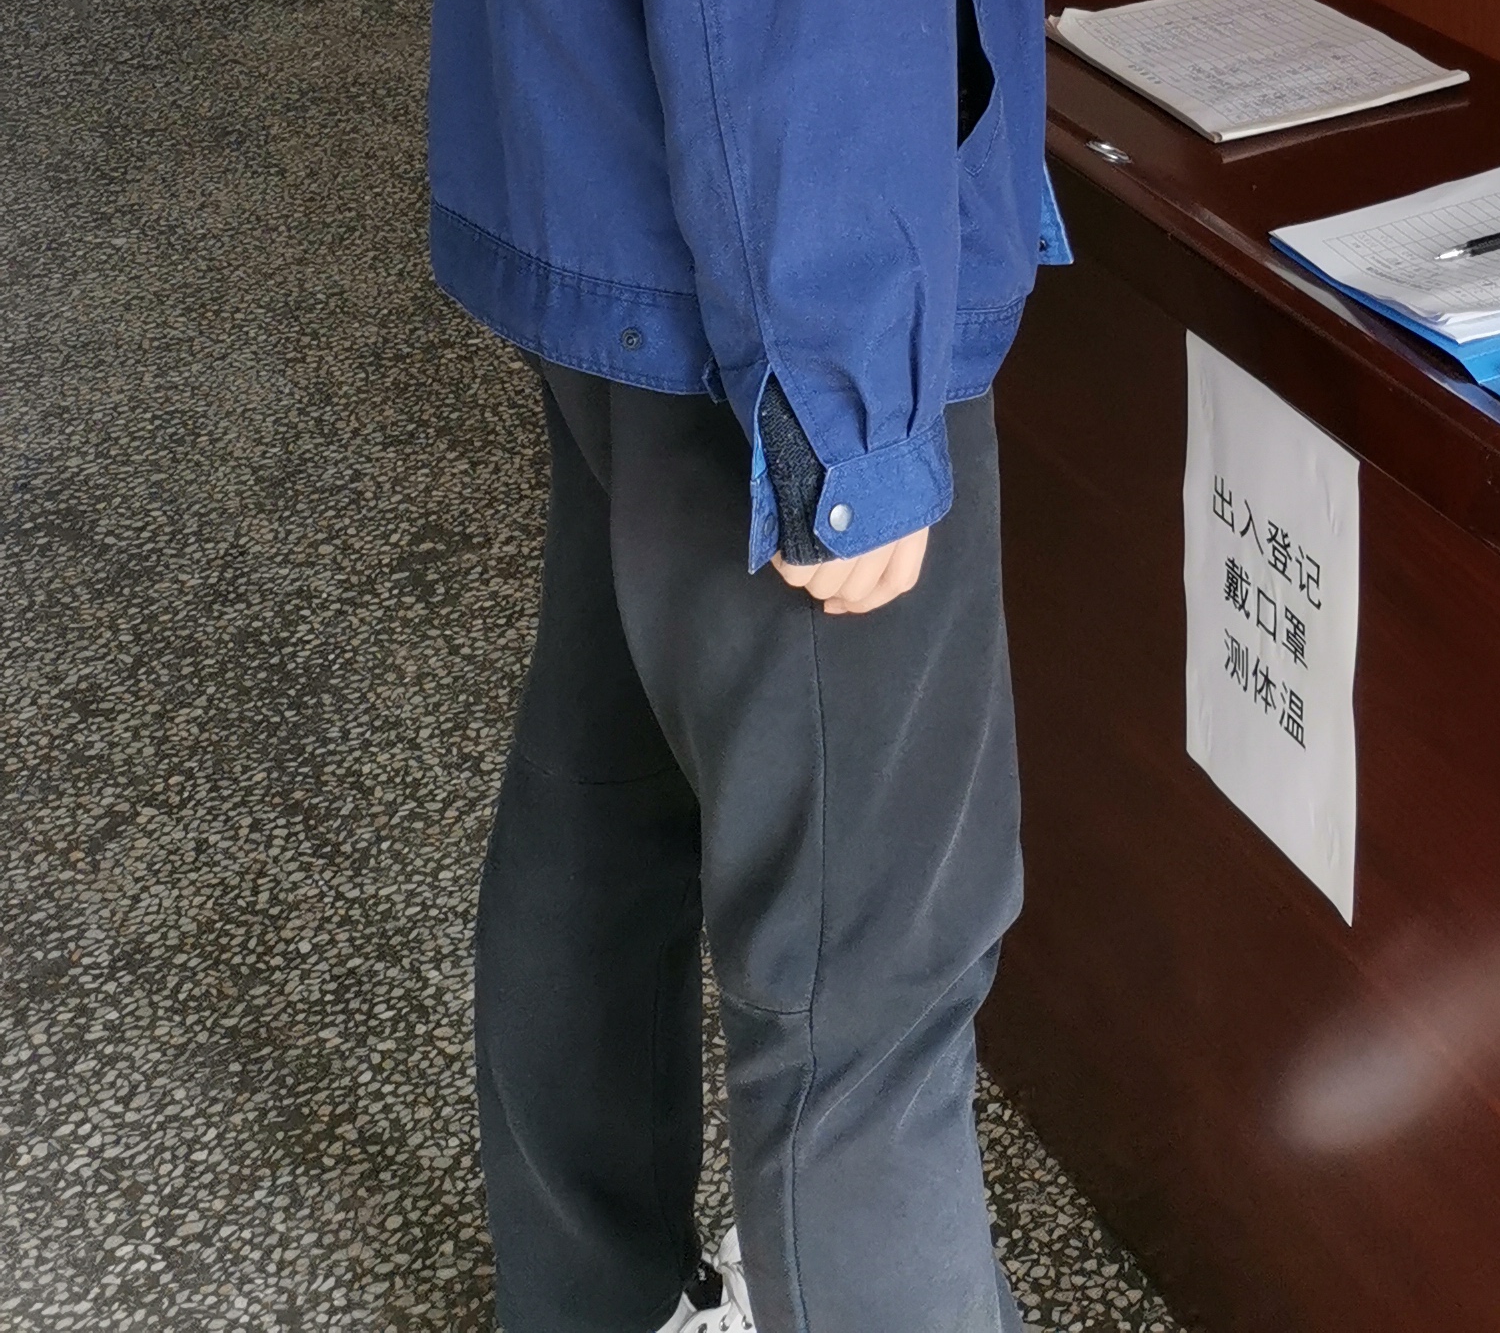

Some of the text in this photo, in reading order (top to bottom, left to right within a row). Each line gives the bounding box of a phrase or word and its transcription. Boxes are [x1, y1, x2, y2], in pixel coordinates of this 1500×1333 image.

[1212, 474, 1323, 611] 出入登记
[1224, 555, 1309, 670] 戴口罩
[1223, 627, 1307, 750] 测体温
